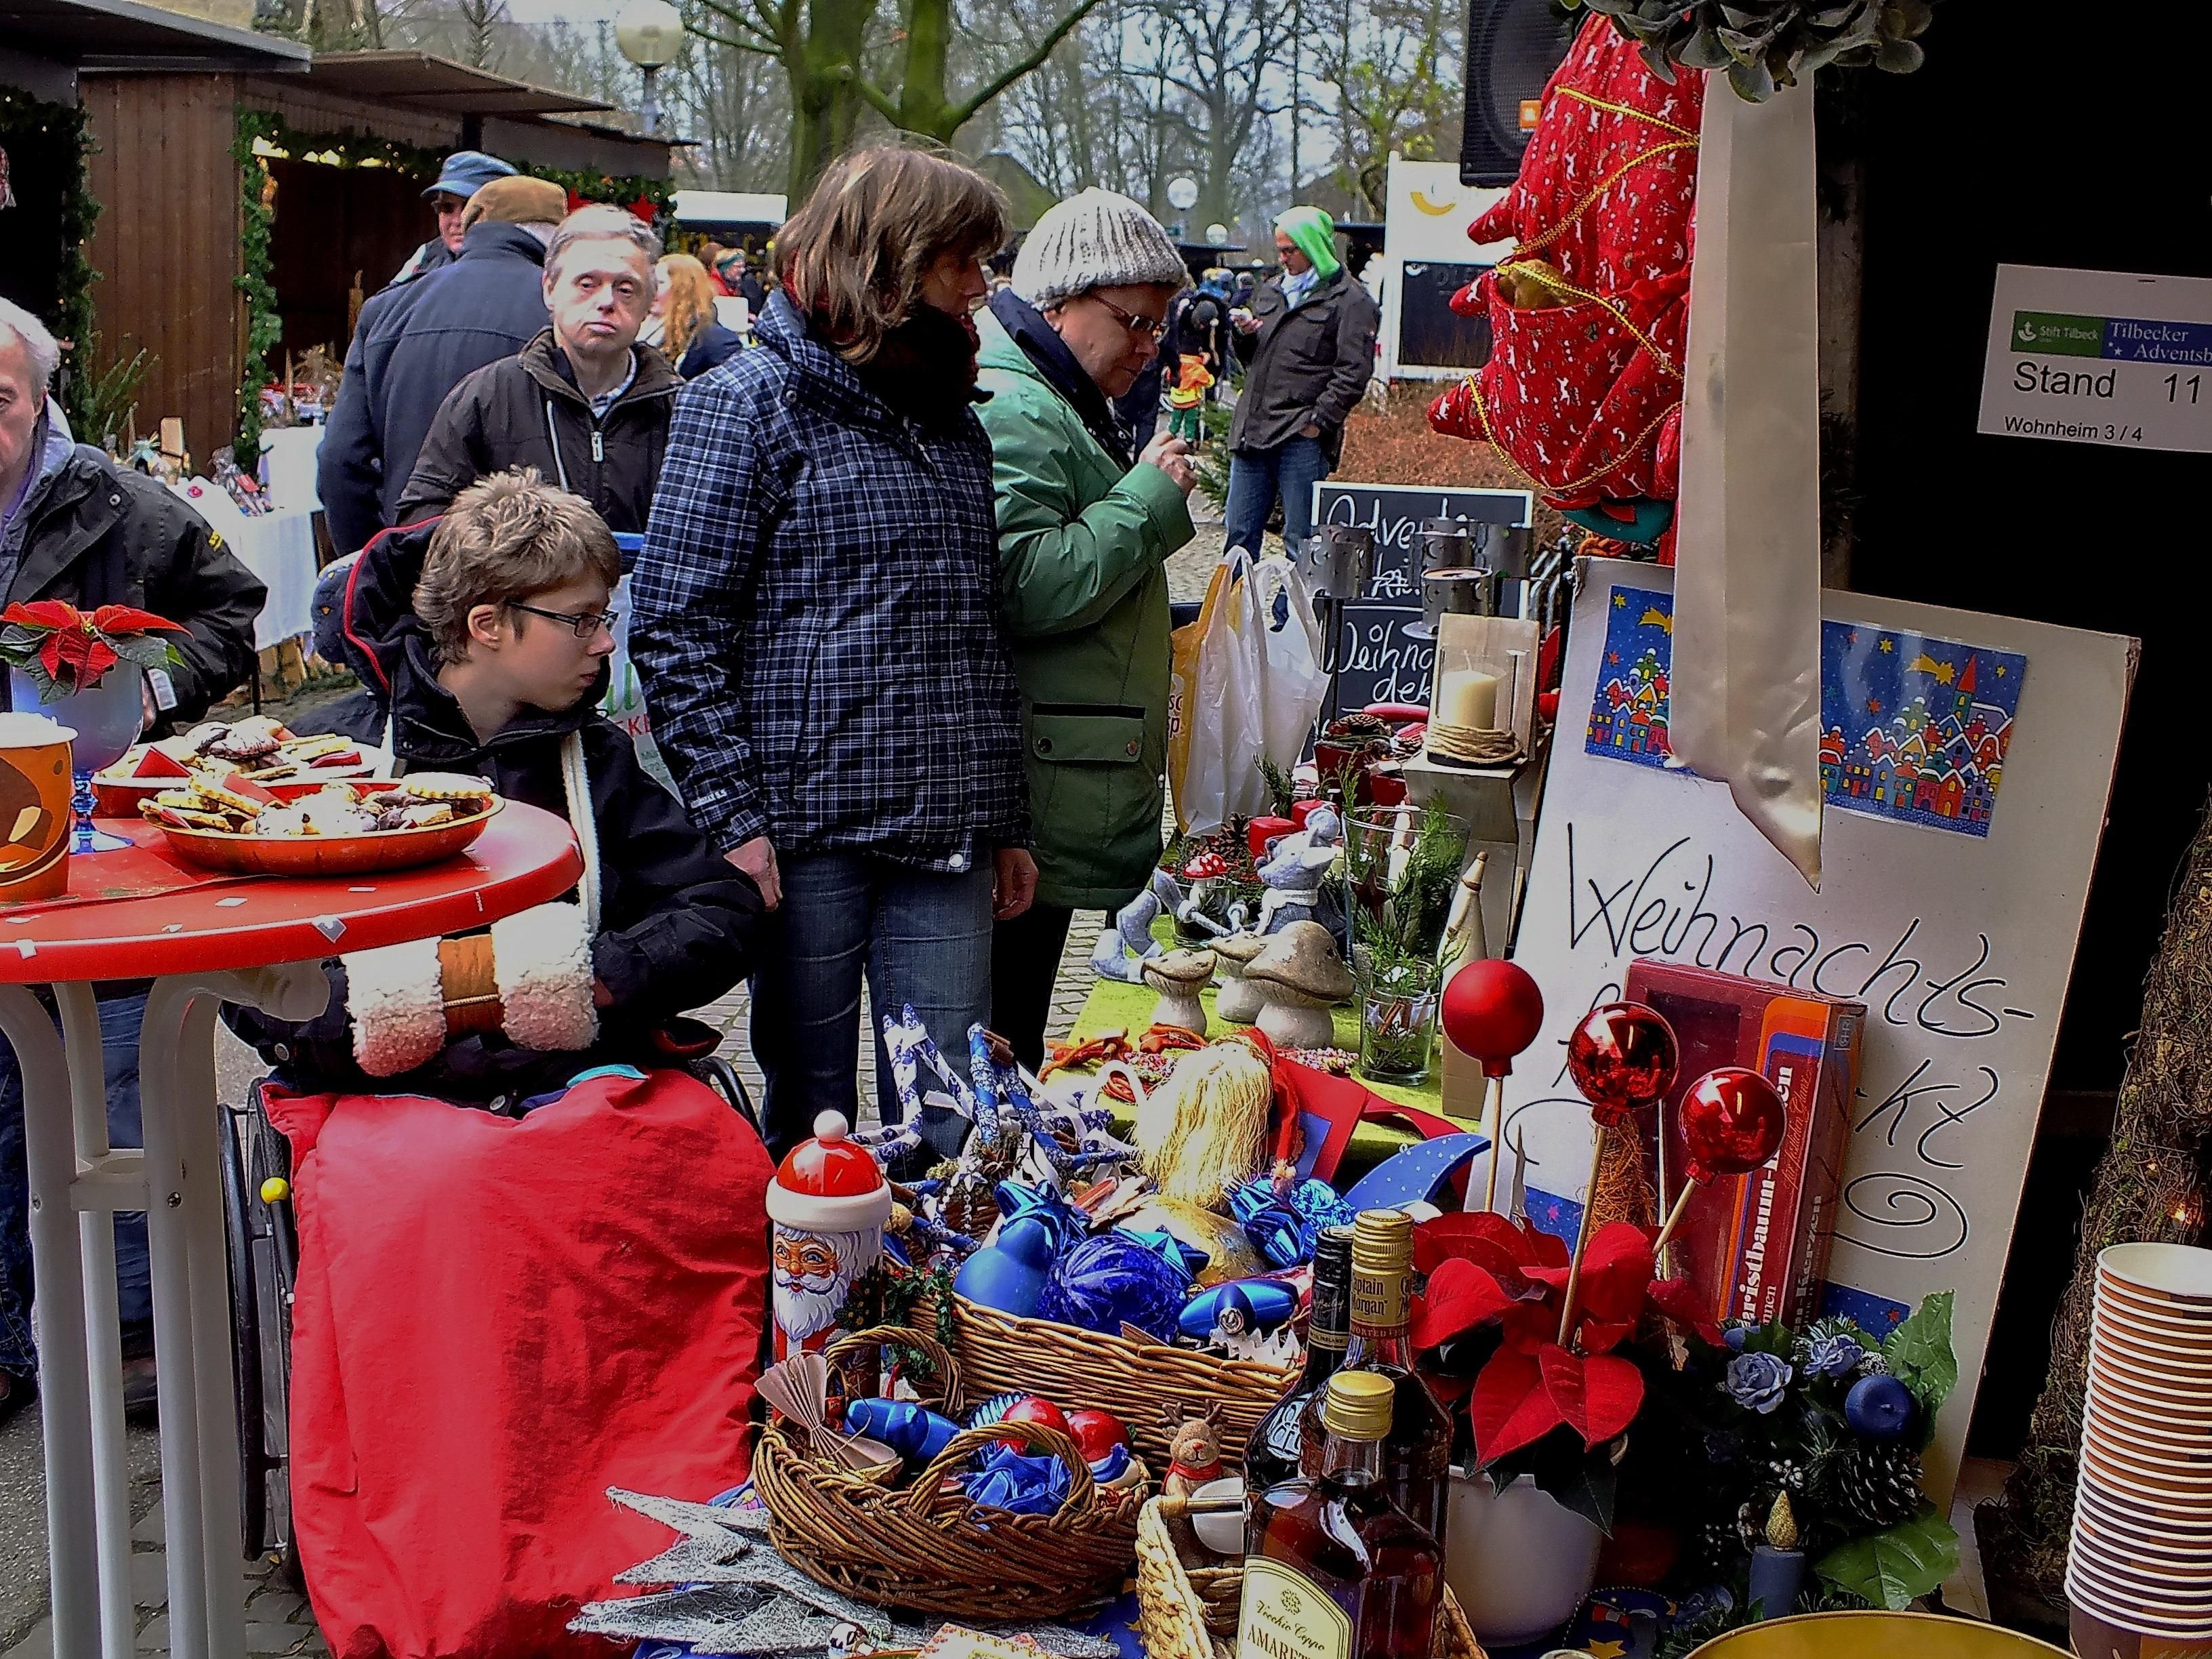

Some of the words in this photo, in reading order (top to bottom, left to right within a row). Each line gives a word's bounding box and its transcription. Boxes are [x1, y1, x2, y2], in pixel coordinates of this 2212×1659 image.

[2040, 325, 2061, 337] Stift
[2064, 327, 2099, 340] Tilbeck
[2110, 321, 2189, 342] Tilbecker
[2133, 343, 2212, 363] Adventsb
[2013, 361, 2116, 398] Stand
[2163, 372, 2201, 404] 11
[2004, 415, 2098, 438] Wohnheim
[2104, 424, 2115, 441] 3
[2131, 427, 2143, 442] 4
[1568, 821, 2035, 1039] Weihnachts-
